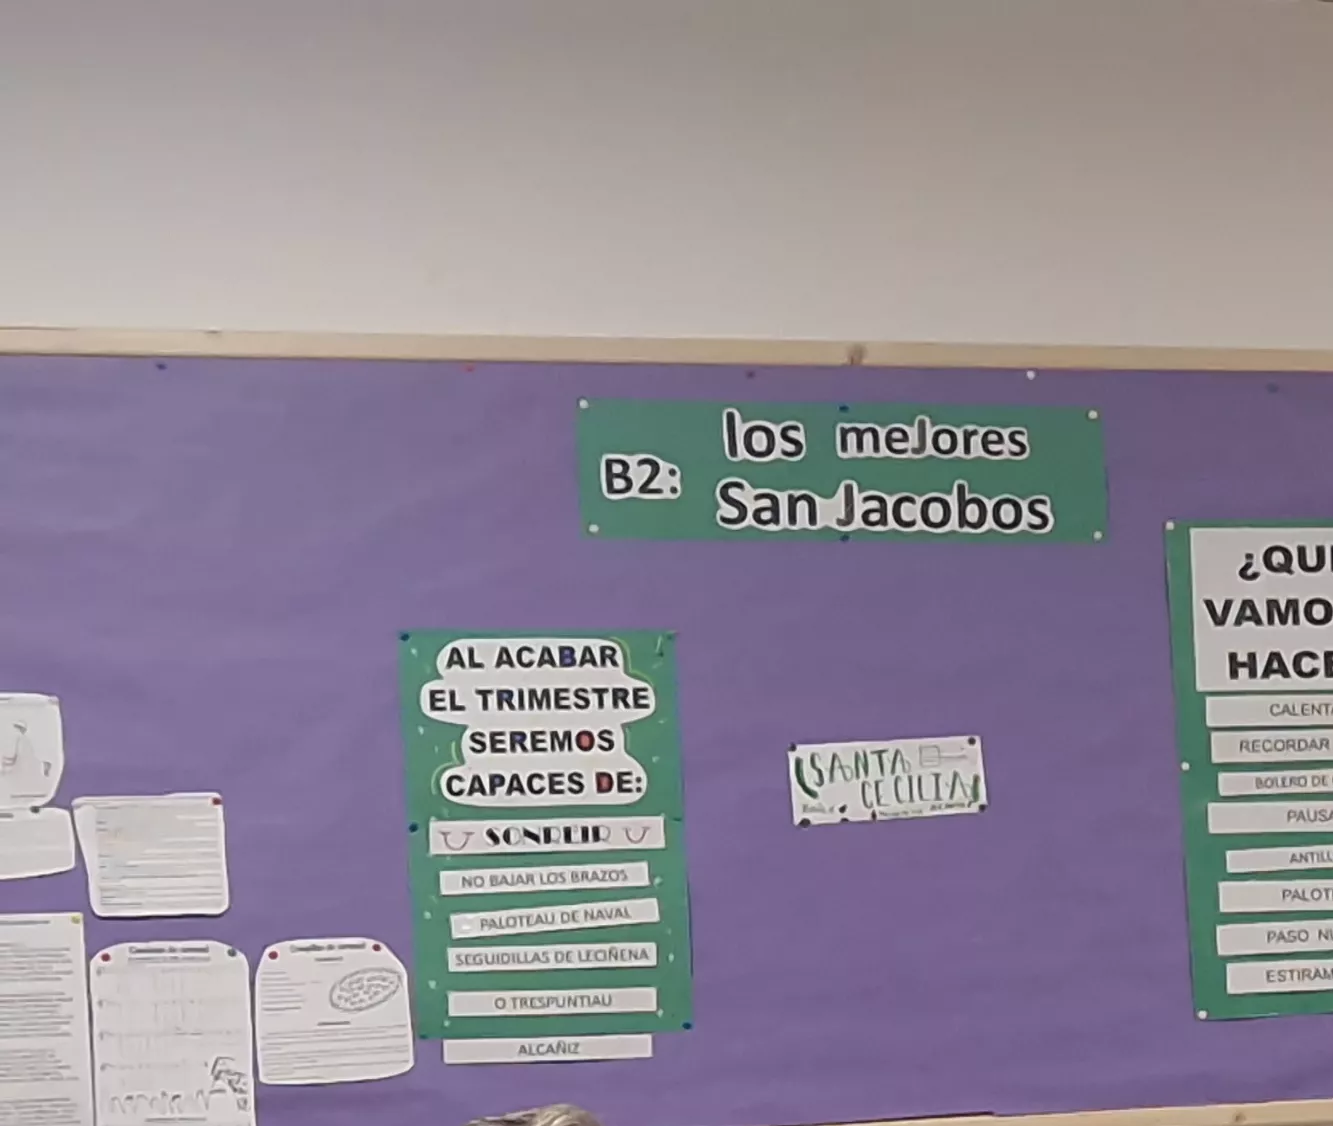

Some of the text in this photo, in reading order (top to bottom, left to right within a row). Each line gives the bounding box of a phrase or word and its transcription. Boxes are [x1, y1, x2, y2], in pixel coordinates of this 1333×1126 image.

[725, 410, 804, 458] los
[604, 458, 680, 496] B2:
[717, 480, 1052, 530] San Jacobos
[445, 645, 619, 669] AL ACABAR
[429, 687, 651, 712] EL TRIMESTRE
[469, 730, 615, 754] SEREMOS
[1239, 737, 1330, 753] RECORDAR
[809, 748, 912, 787] SANTA
[446, 772, 643, 797] CAPACES DE:
[1255, 776, 1308, 790] BOLERO
[1311, 774, 1328, 787] DE
[461, 869, 628, 889] NO BAJAR LOS BRAZOS
[480, 906, 632, 931] PALOTEAU DE NAVAL
[1266, 930, 1310, 944] PASO
[455, 946, 650, 967] SEGUIDILLAS DE LECIÑENA
[493, 993, 612, 1010] O TRESPUNTIAU
[518, 1041, 581, 1057] ALCAÑIZ
